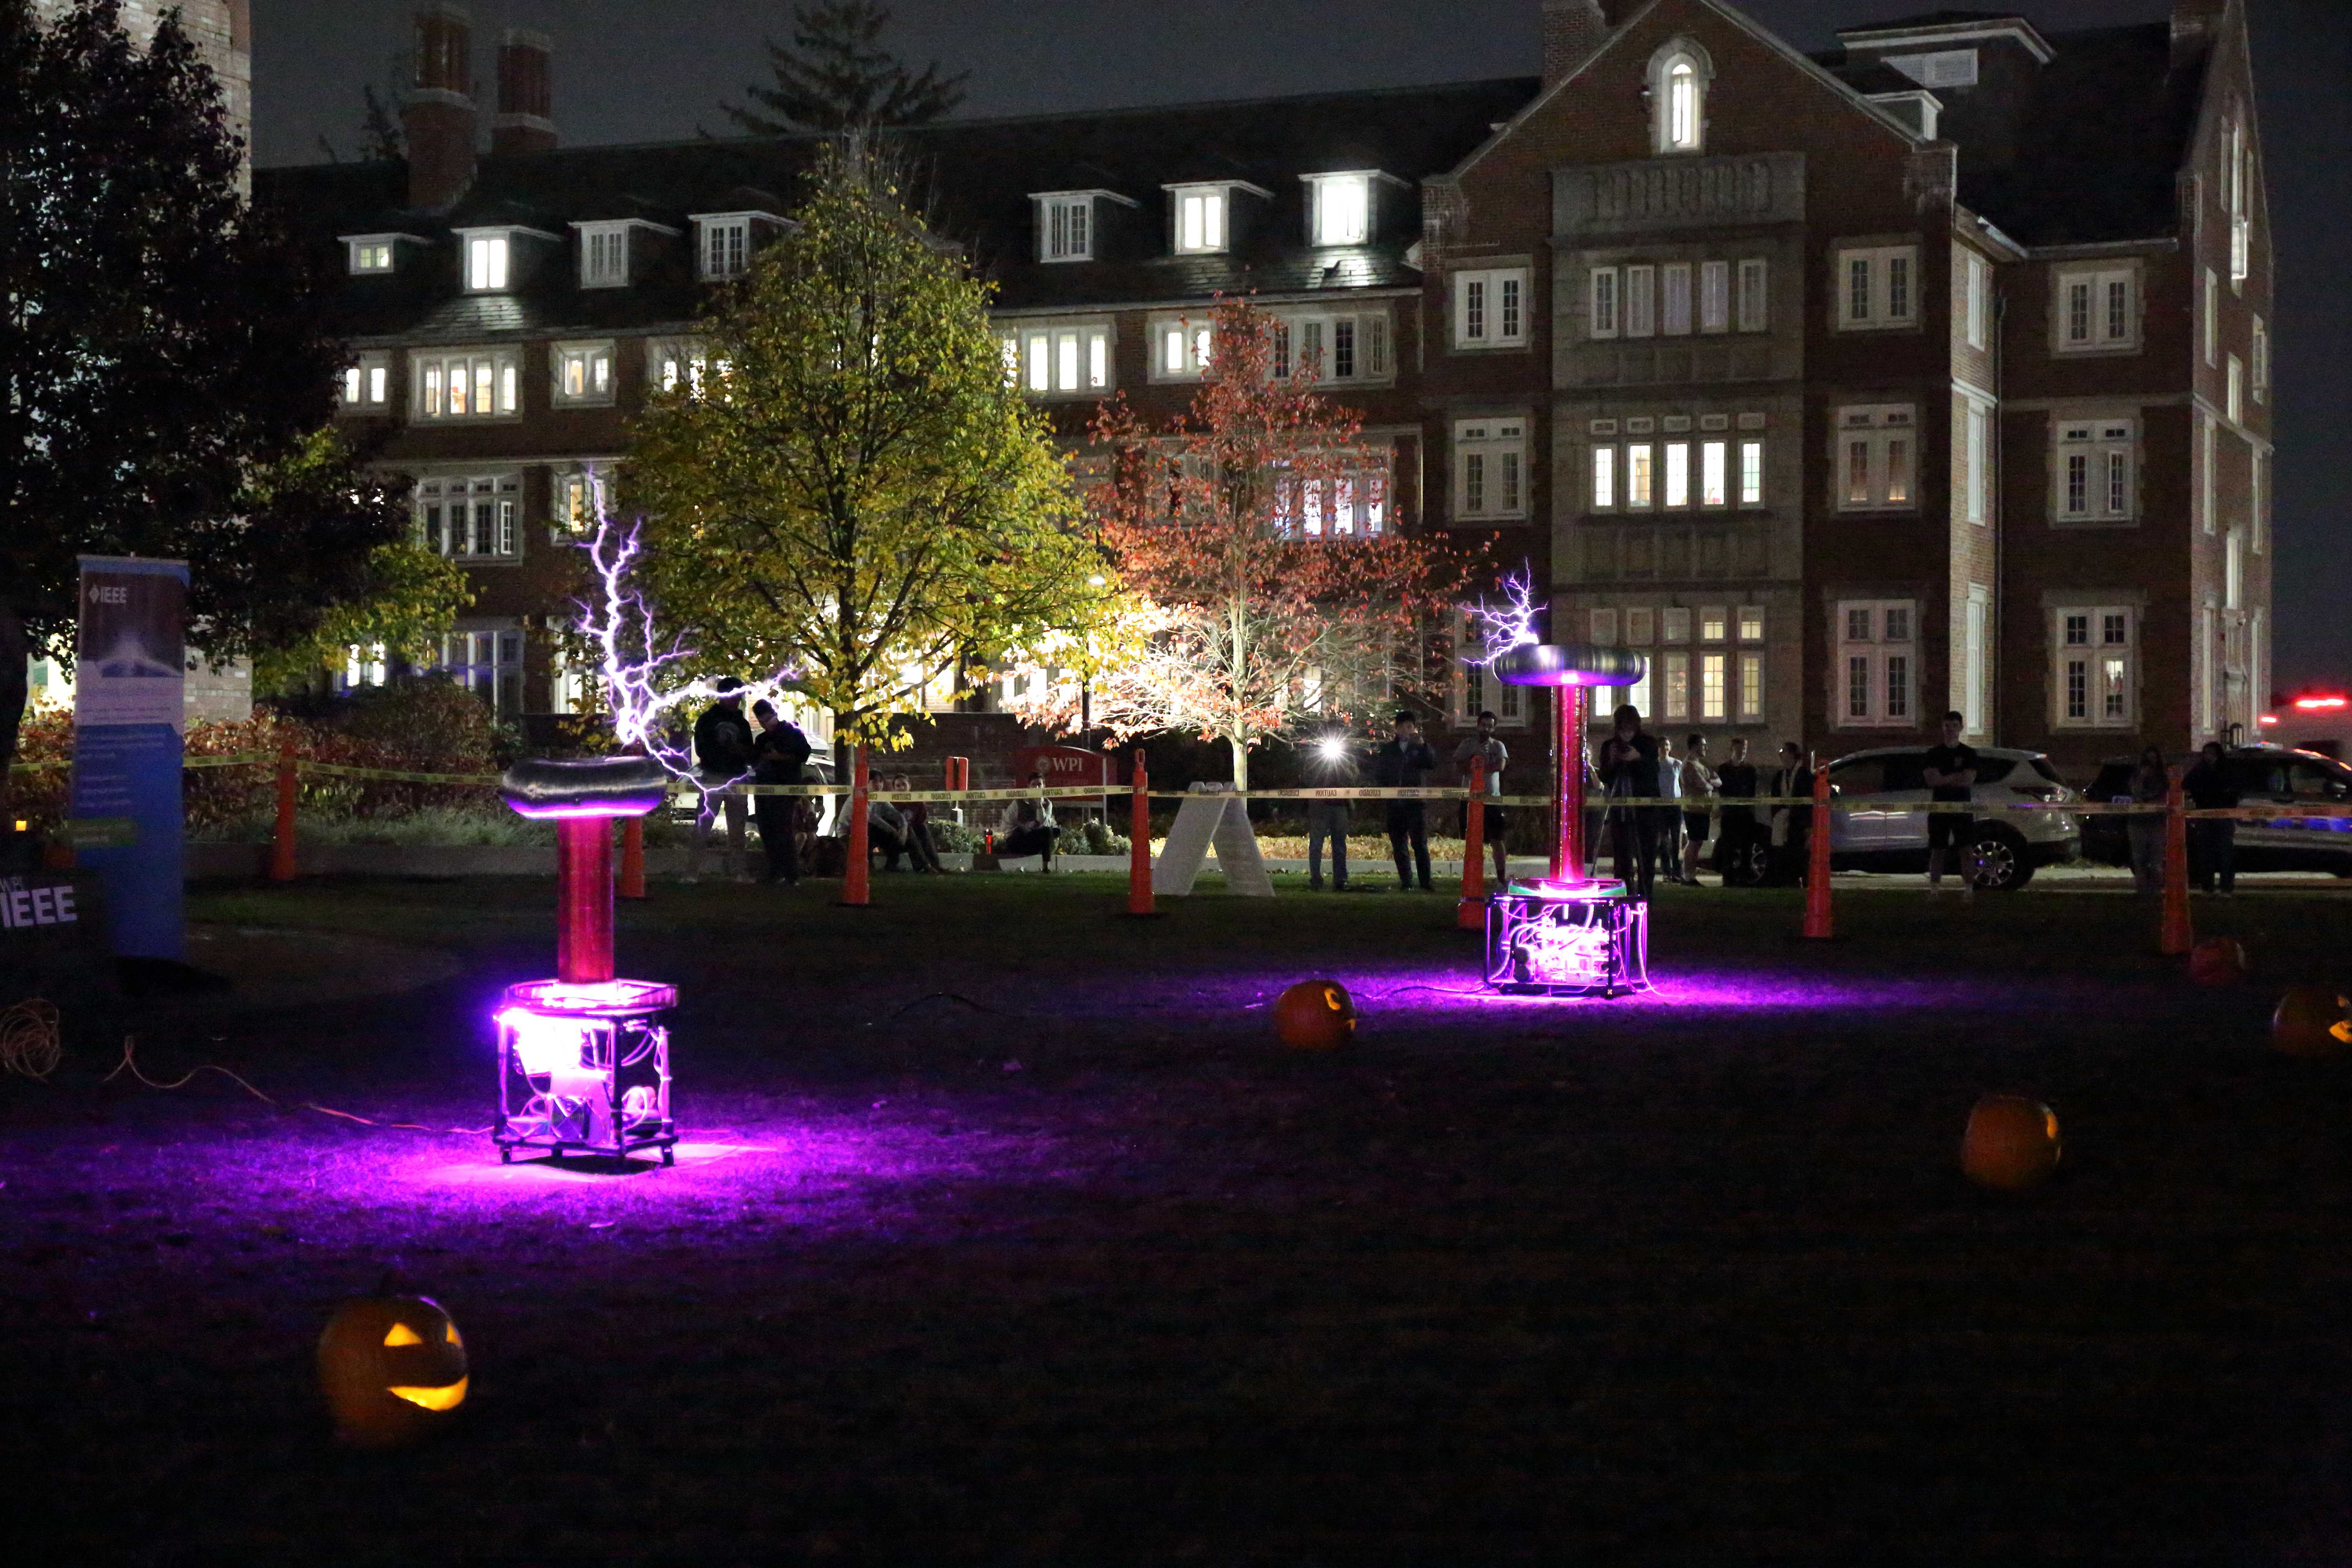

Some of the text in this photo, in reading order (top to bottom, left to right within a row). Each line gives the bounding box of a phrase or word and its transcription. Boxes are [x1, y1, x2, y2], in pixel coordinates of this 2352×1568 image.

[100, 587, 127, 603] IEEE
[1052, 757, 1083, 771] WPI
[0, 885, 78, 928] IEEE
